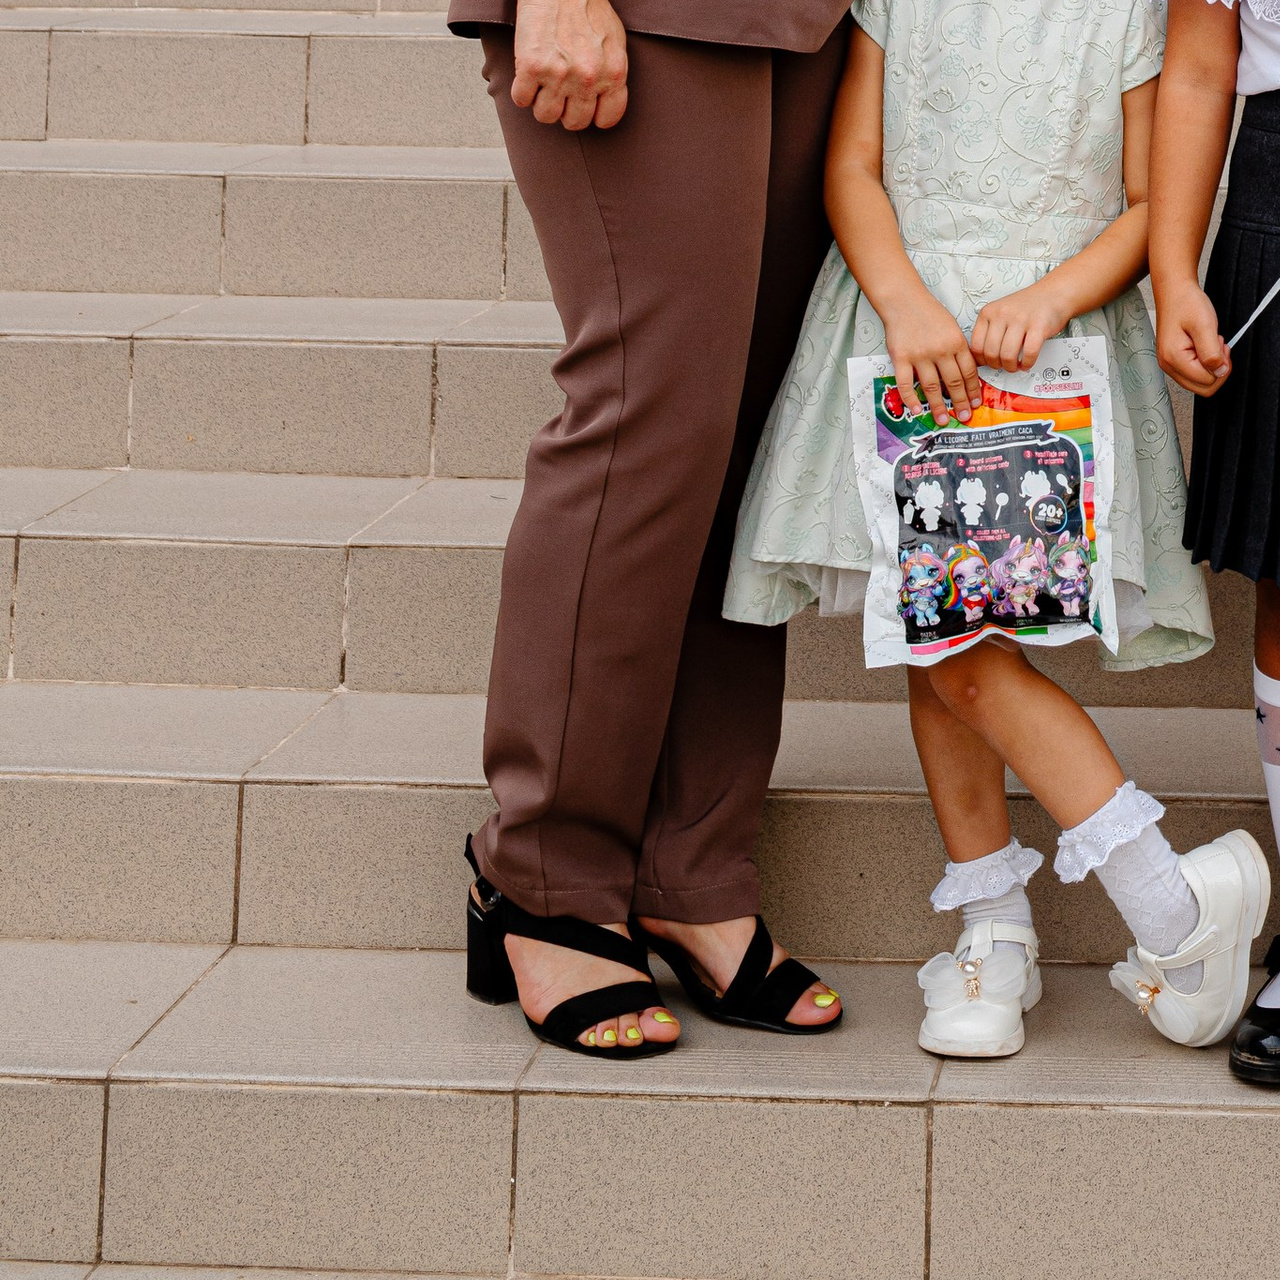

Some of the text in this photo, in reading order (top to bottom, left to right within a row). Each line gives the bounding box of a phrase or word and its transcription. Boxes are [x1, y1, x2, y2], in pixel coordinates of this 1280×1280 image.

[934, 436, 942, 444] LA
[944, 435, 969, 444] LICORNE
[971, 433, 986, 441] FAIT
[989, 428, 1015, 439] VRAIMENT
[1038, 503, 1063, 517] 20+
